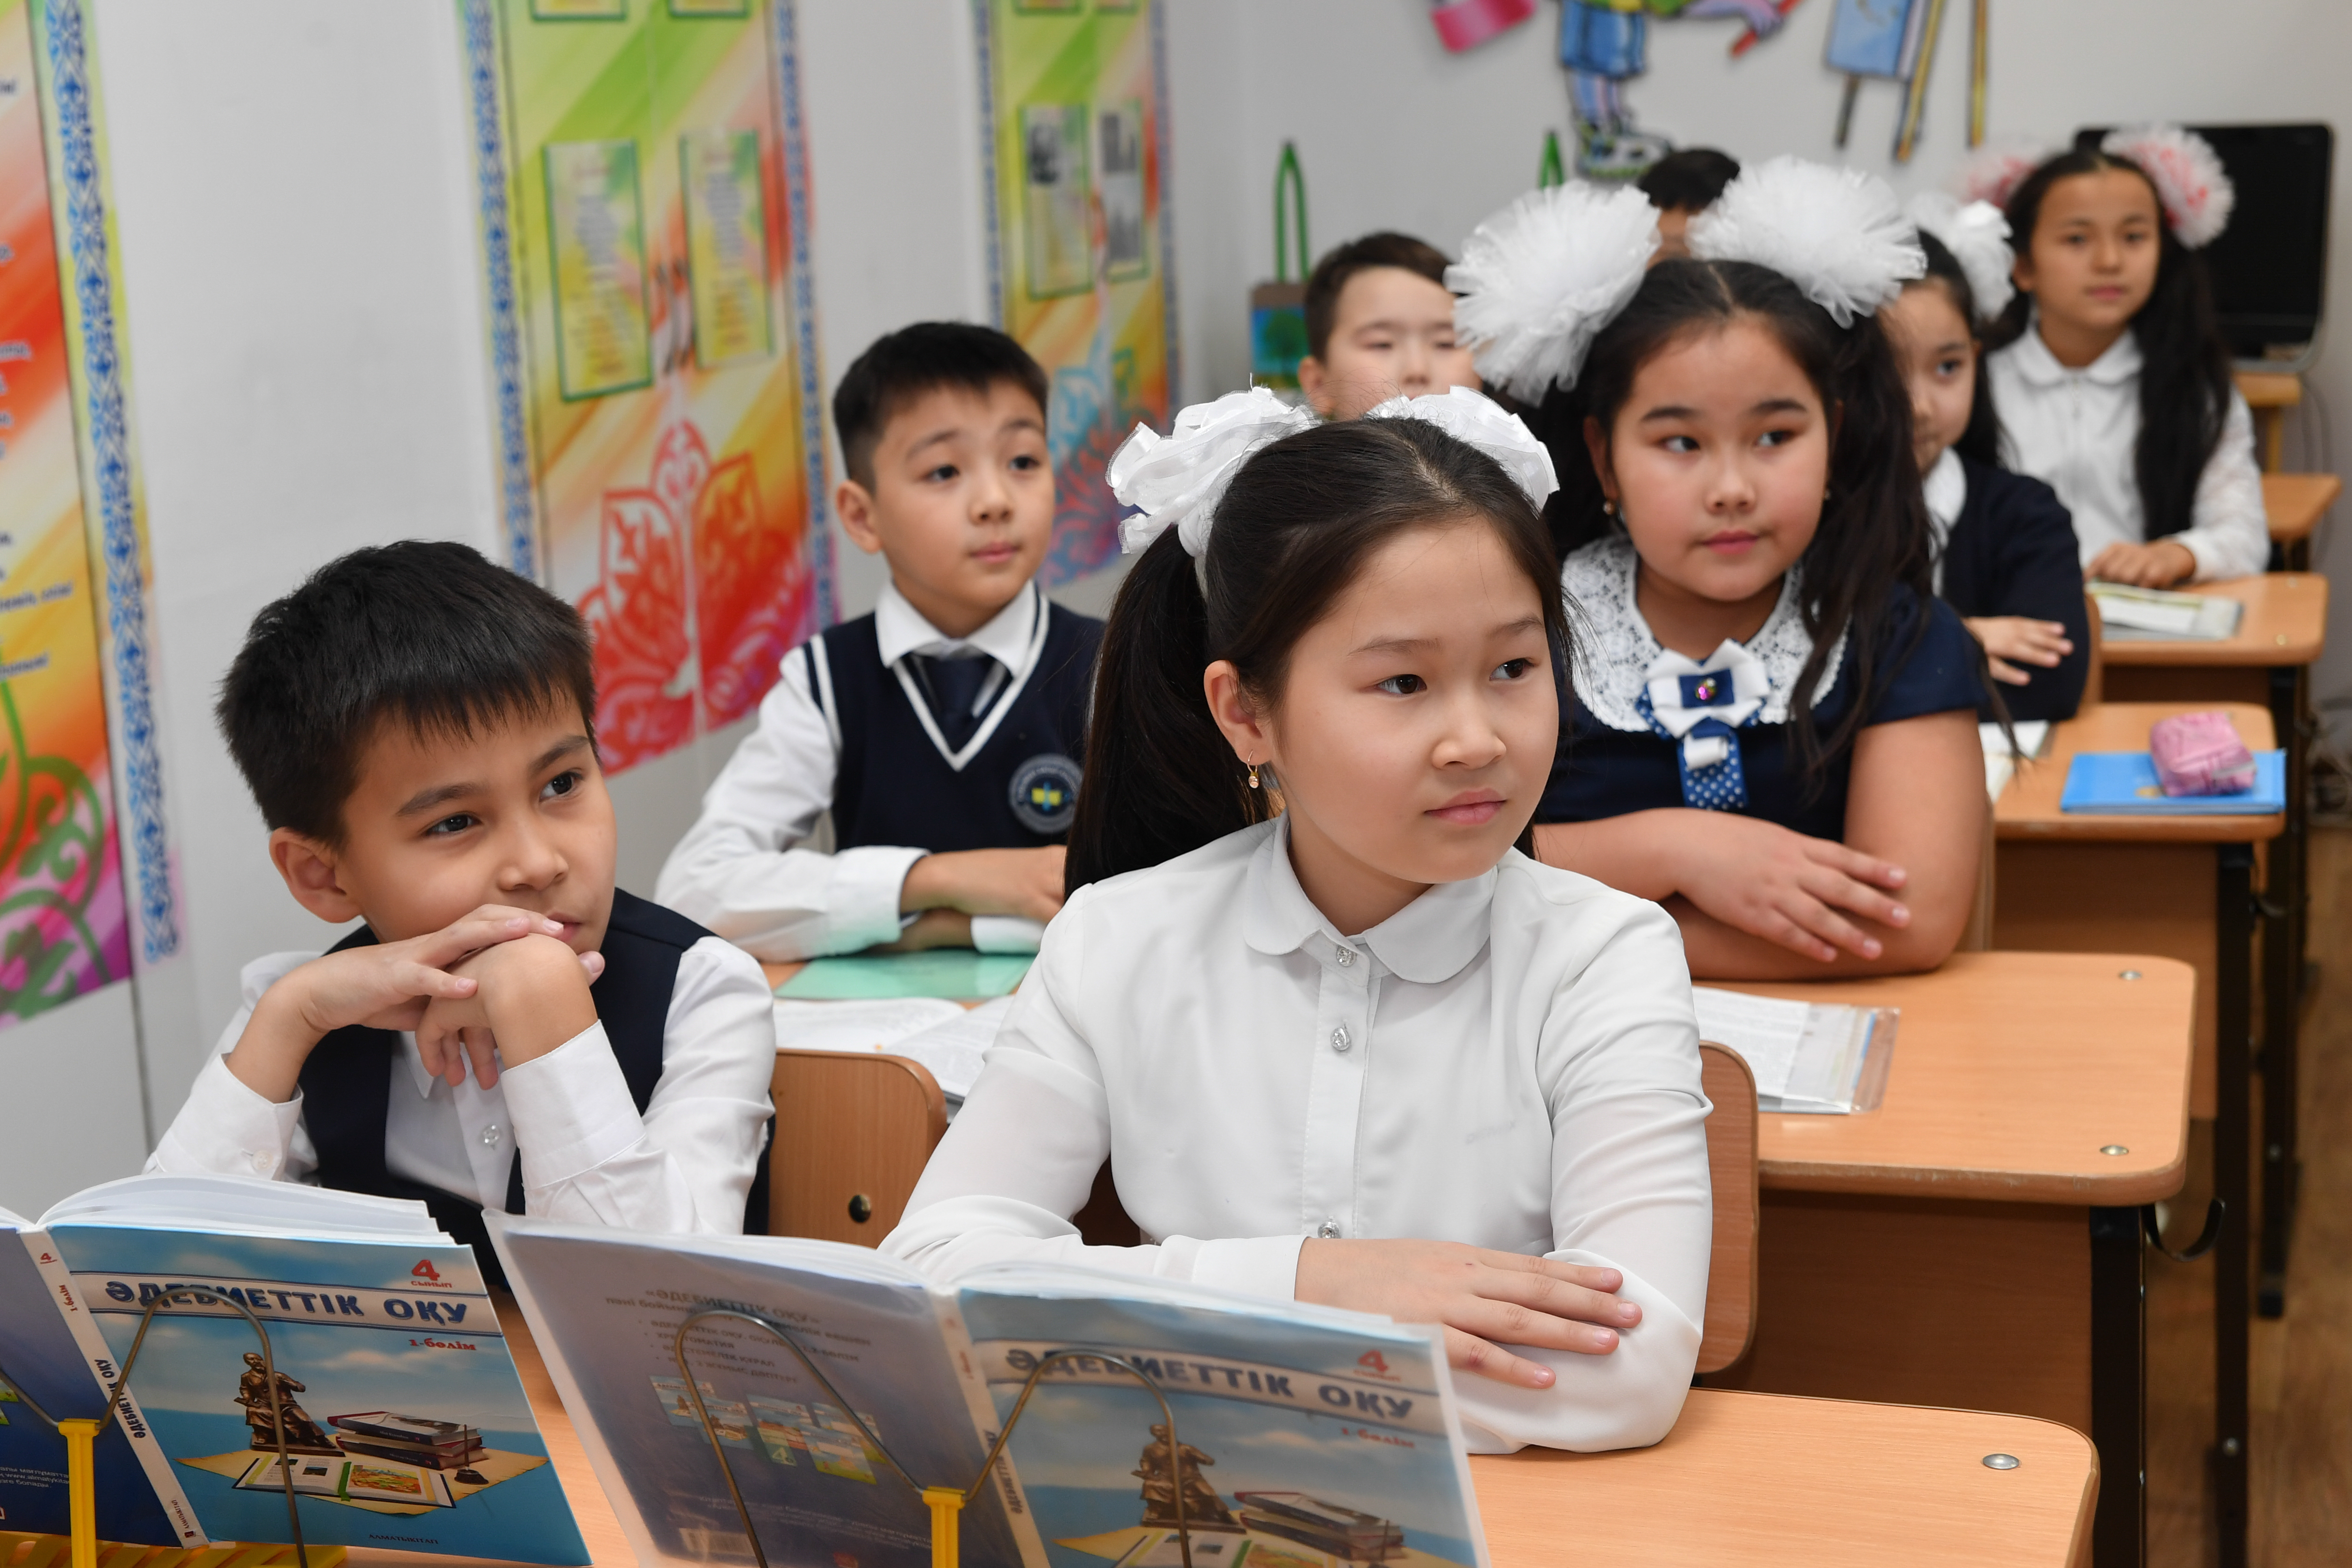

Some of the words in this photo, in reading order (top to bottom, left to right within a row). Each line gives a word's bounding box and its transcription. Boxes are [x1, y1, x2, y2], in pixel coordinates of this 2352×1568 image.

[412, 1260, 440, 1281] 4
[106, 1281, 364, 1316] ӘДЕБИЕТТІК
[383, 1298, 466, 1325] ОҚУ
[409, 1338, 476, 1350] 1-бөлім
[656, 1332, 734, 1348] ХРЕТОМАТИЯ
[94, 1359, 115, 1378] ОҚУ
[1358, 1349, 1389, 1373] 4
[107, 1382, 146, 1439] ӘДЕБИЕТК
[1318, 1384, 1413, 1419] ОҚУ
